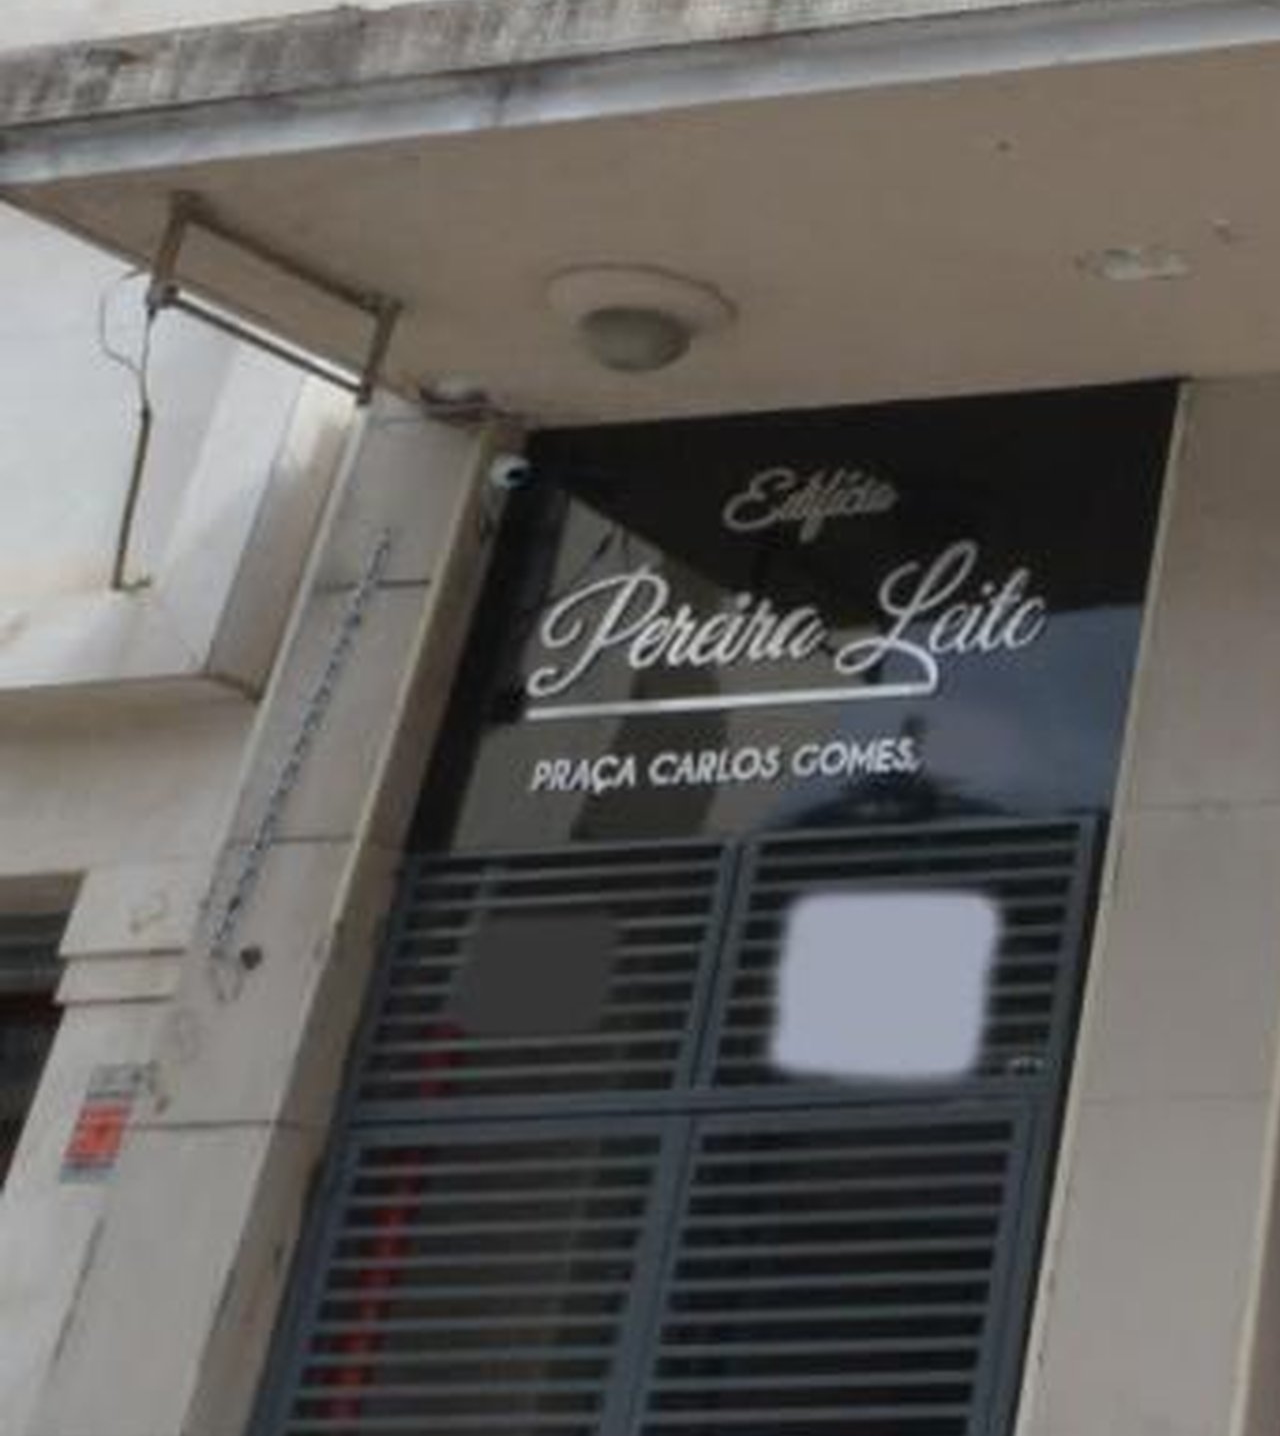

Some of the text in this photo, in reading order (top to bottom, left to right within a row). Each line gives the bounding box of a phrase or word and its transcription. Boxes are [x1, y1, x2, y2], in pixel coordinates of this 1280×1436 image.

[526, 539, 1048, 697] Pereira Leite
[529, 753, 637, 793] PRAÇA
[648, 744, 780, 786] CARLOS
